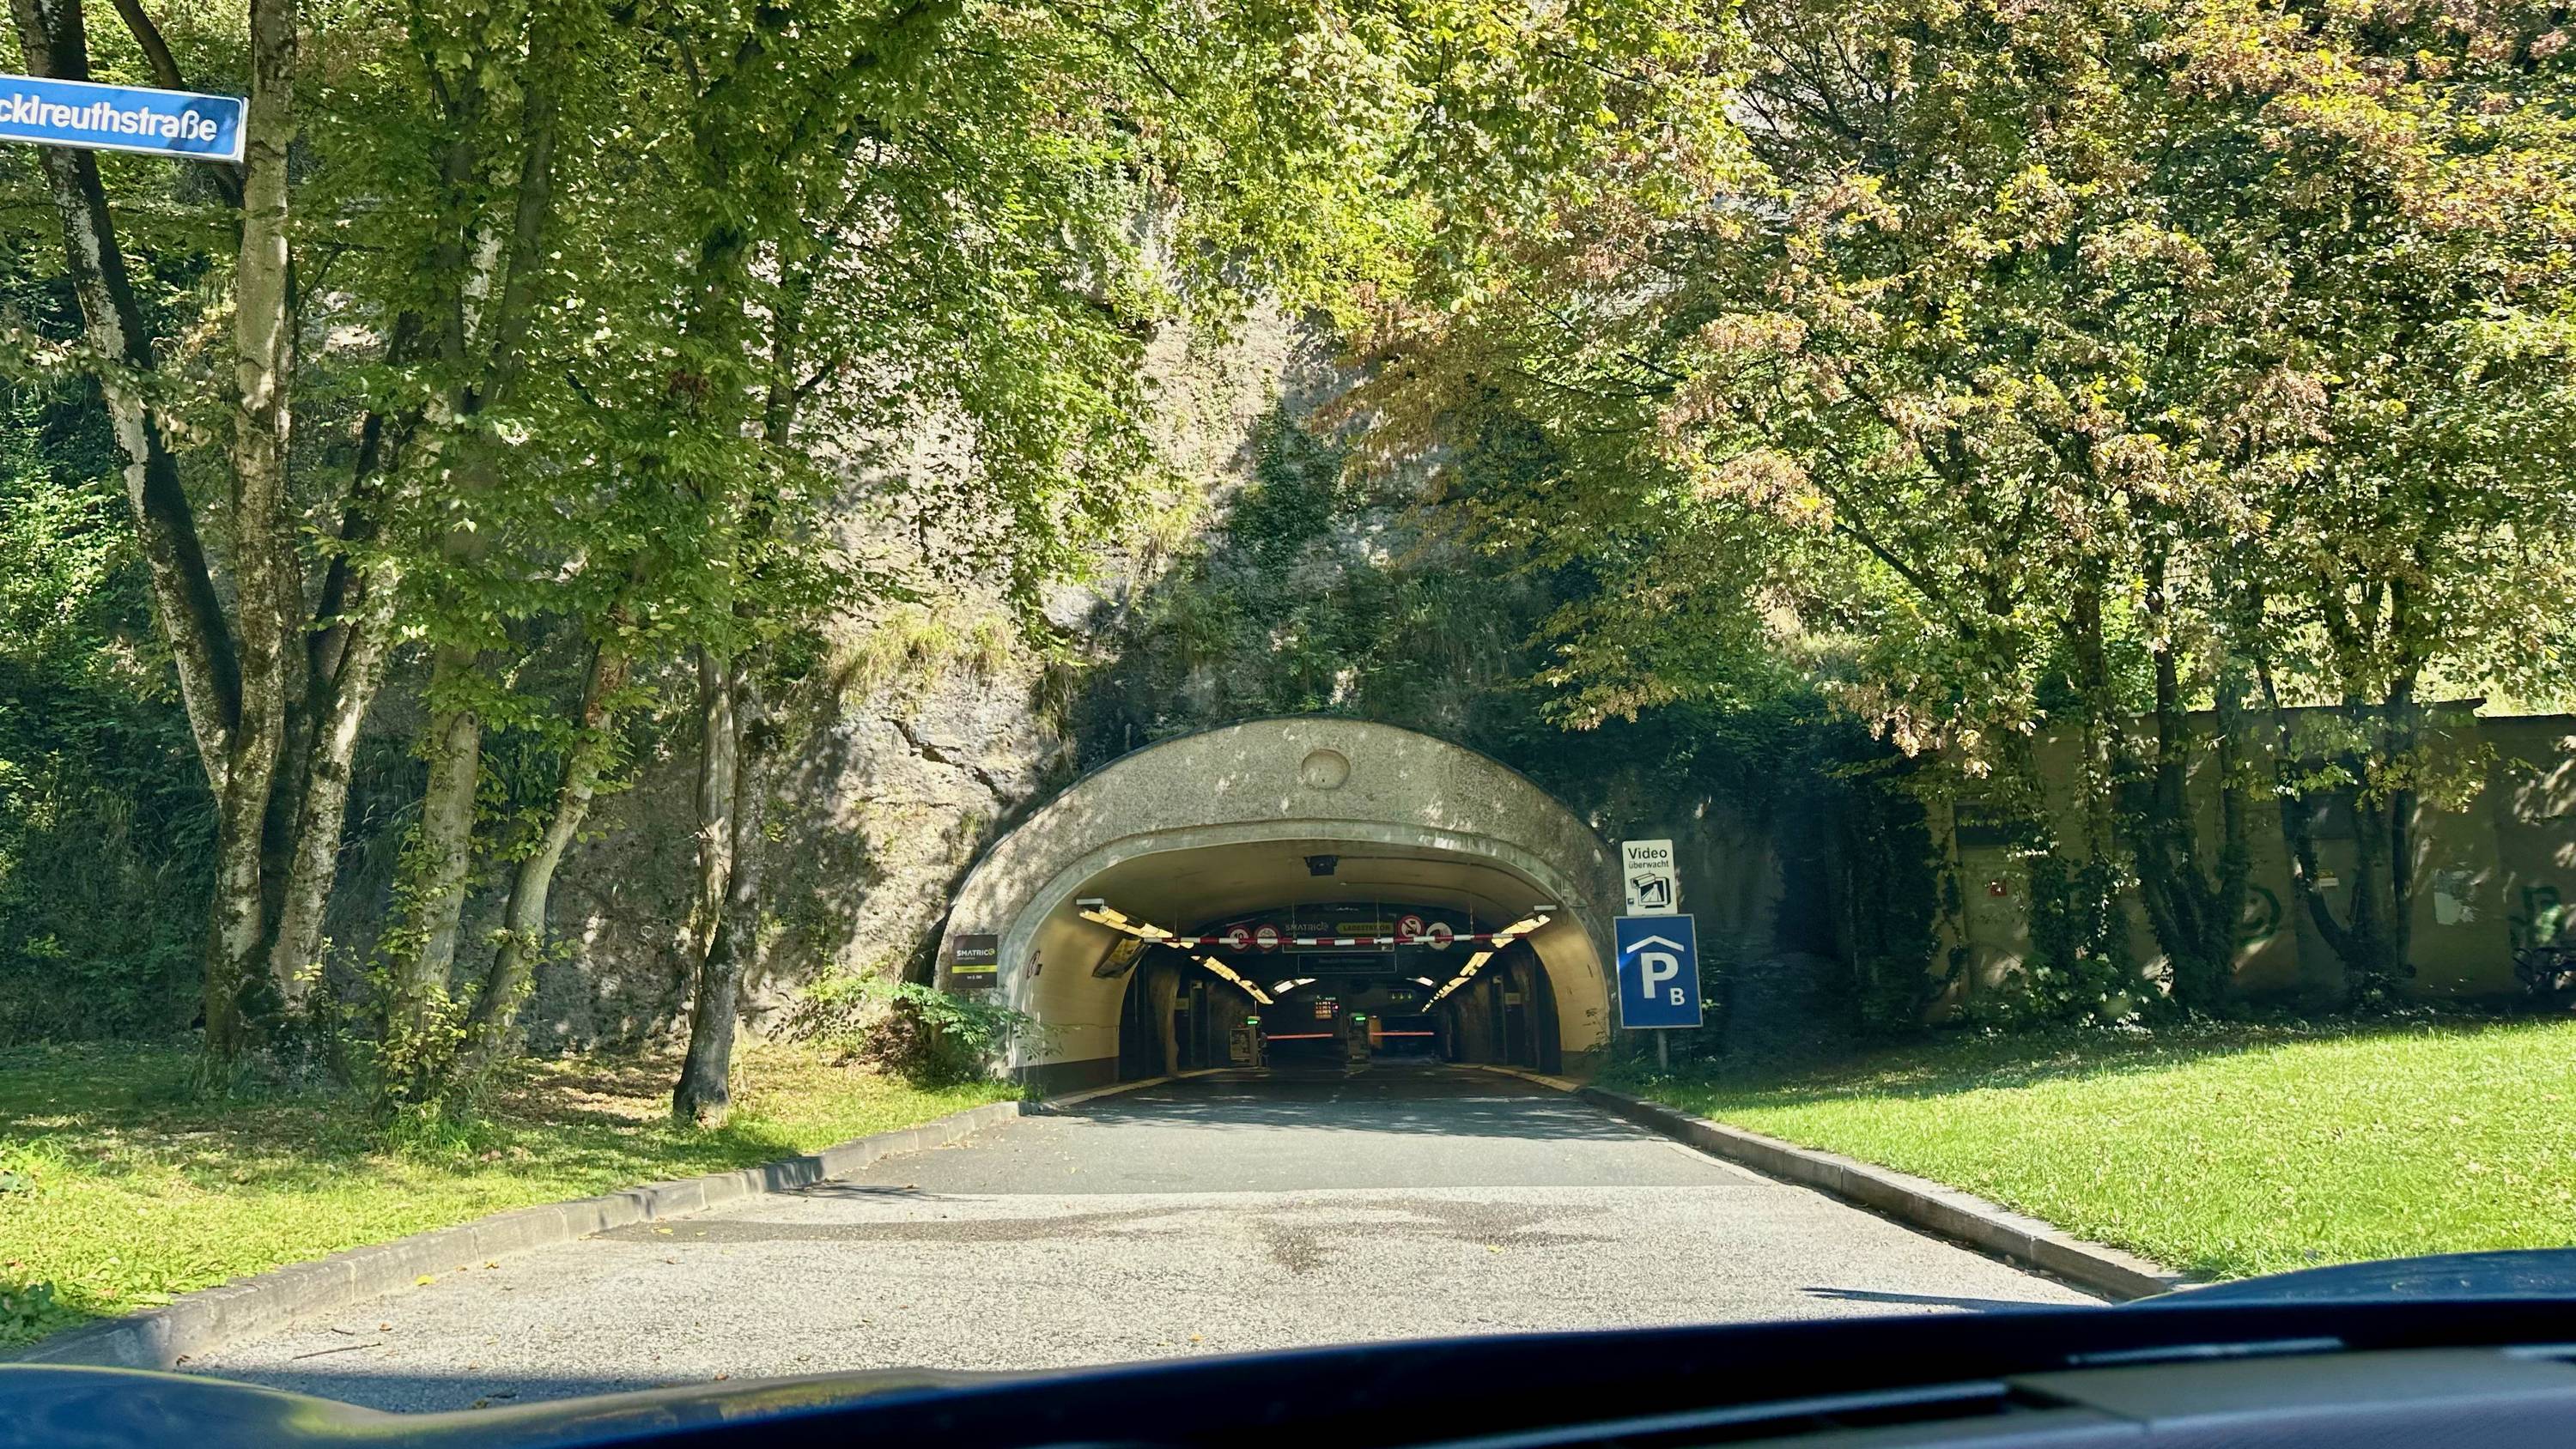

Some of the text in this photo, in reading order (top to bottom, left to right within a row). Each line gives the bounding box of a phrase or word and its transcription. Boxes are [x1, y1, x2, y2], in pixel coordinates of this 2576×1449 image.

[0, 93, 217, 142] cklreuthstraße
[1628, 847, 1668, 859] Video
[1628, 860, 1669, 869] überwacht
[1641, 952, 1679, 999] P
[1670, 987, 1686, 1006] B
